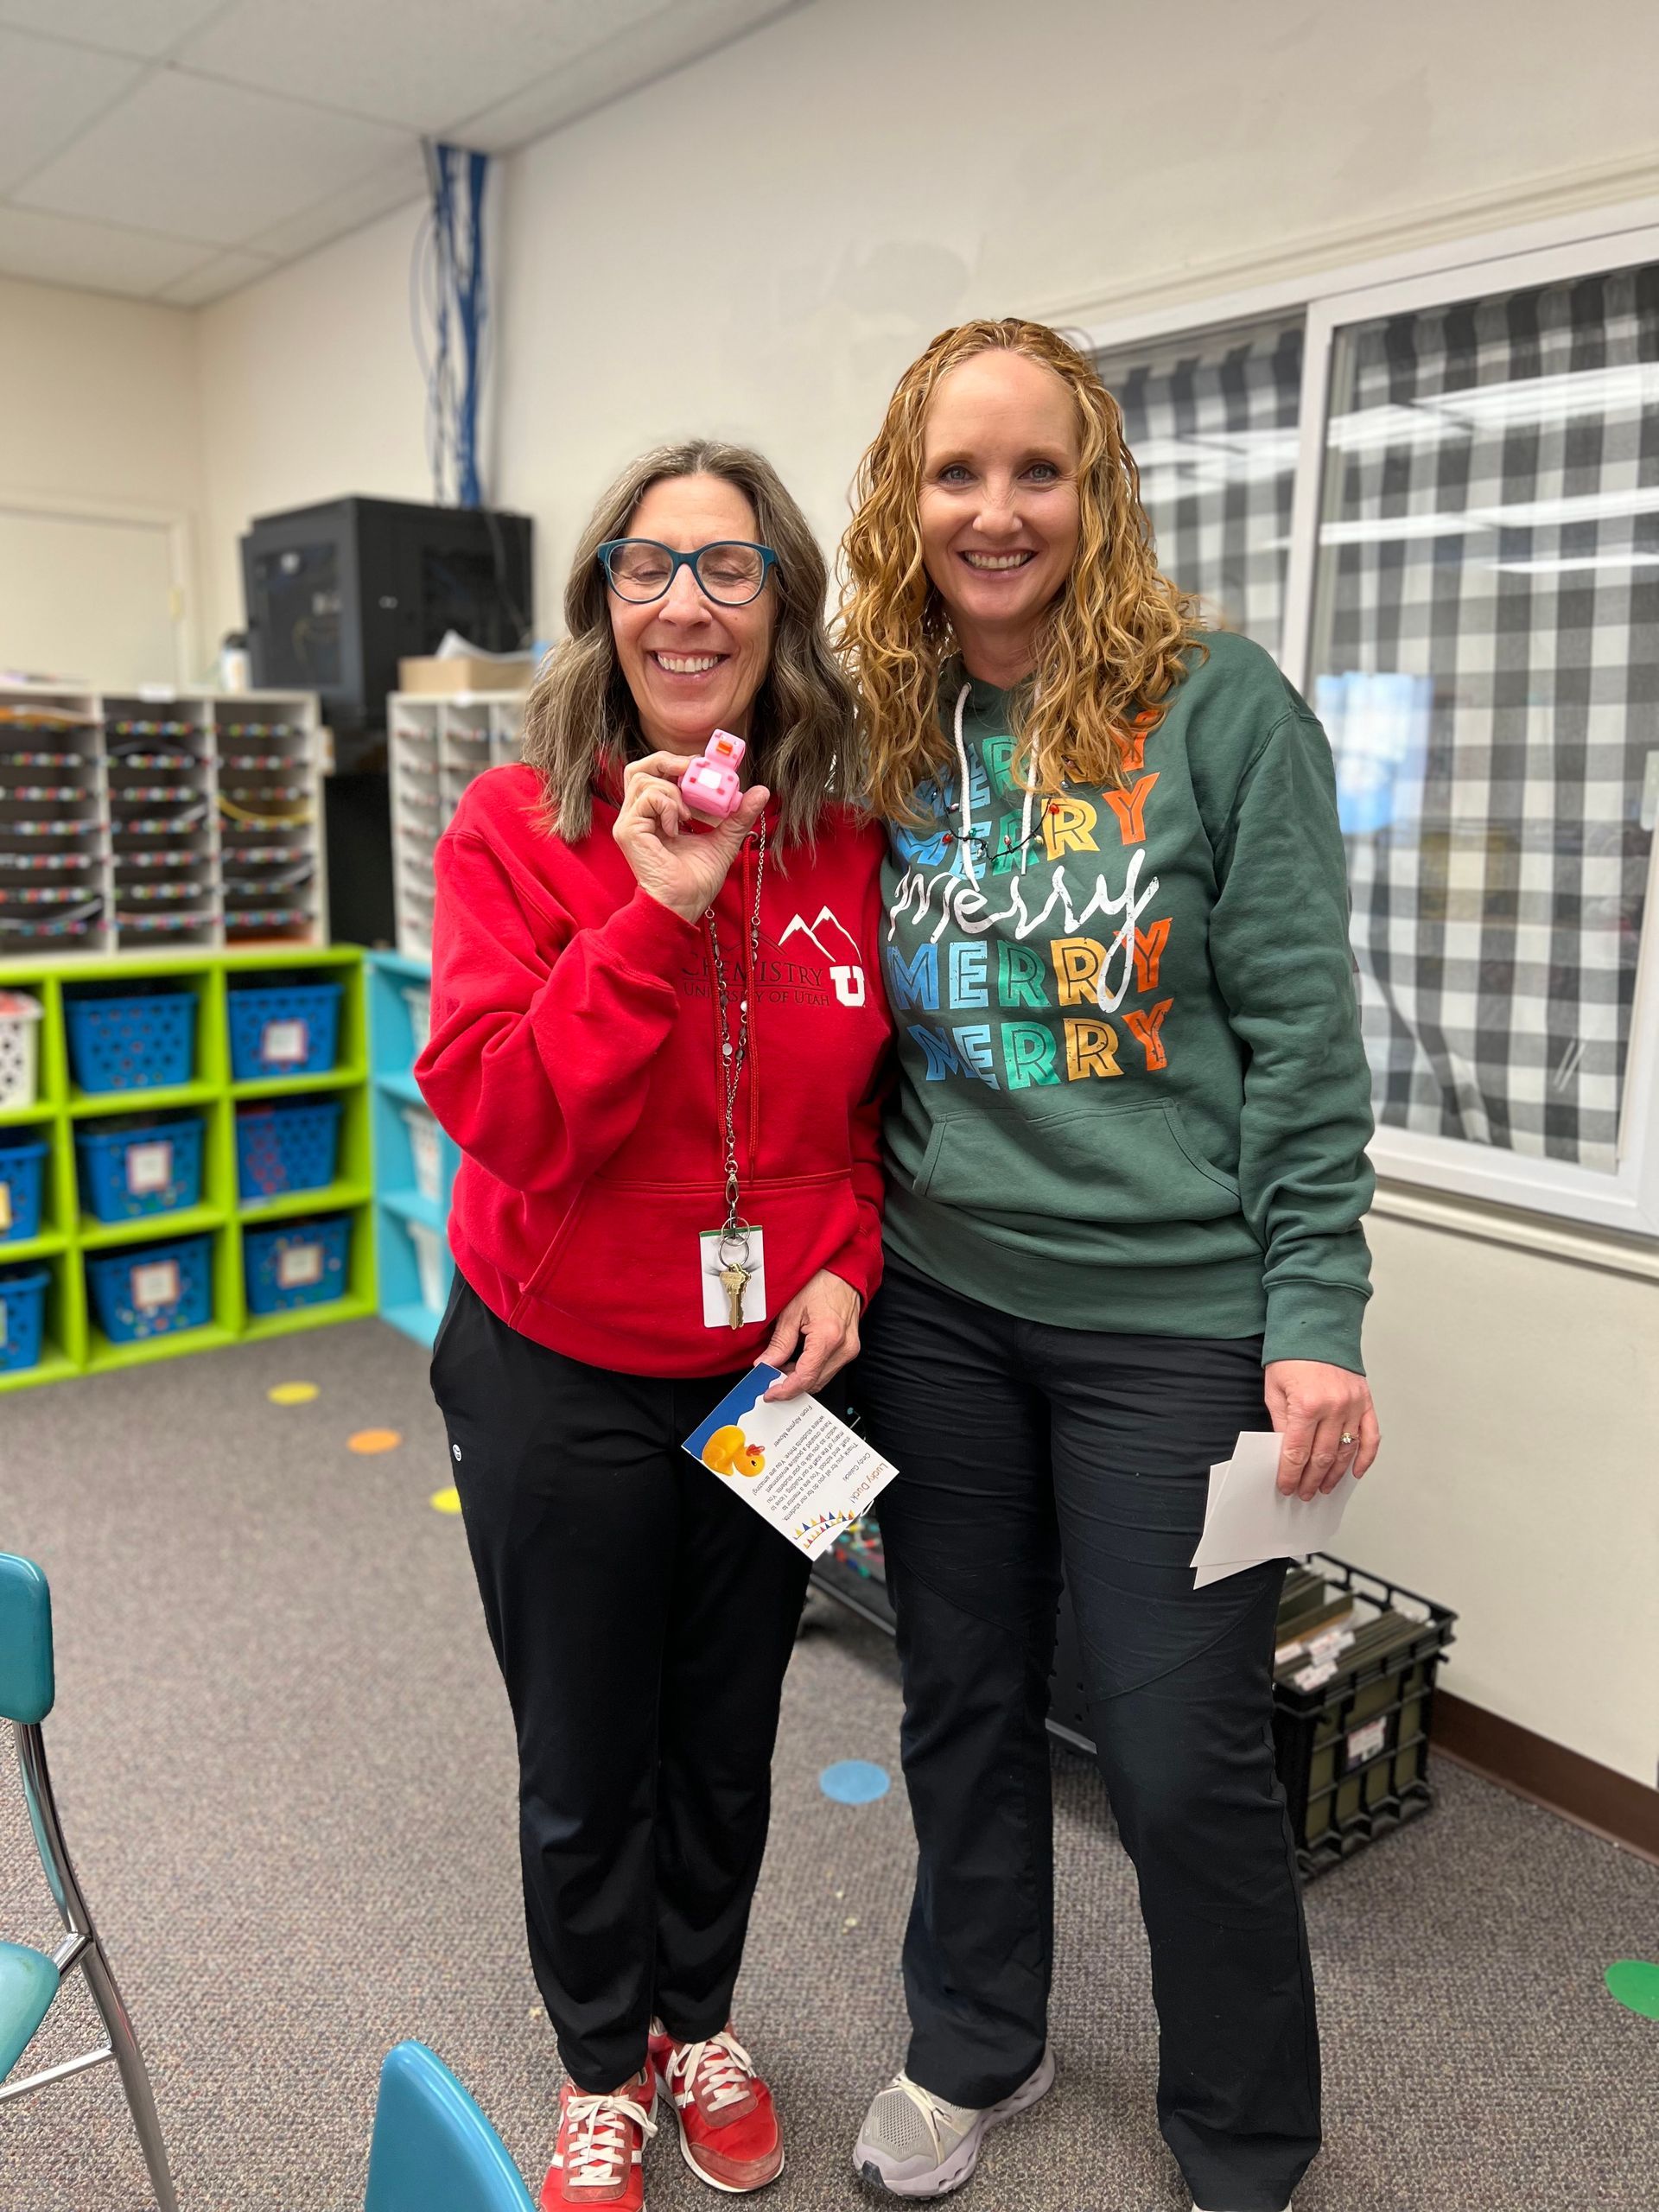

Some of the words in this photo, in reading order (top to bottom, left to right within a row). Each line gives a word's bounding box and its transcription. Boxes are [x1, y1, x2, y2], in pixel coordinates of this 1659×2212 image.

[914, 709, 1160, 815] ERY
[887, 918, 1173, 1010] MERRY
[830, 965, 865, 1007] U
[683, 982, 765, 1003] UNIRSIY
[769, 990, 789, 1003] OF
[794, 991, 830, 1007] UTAH
[906, 997, 1173, 1090] MERRY
[799, 1404, 812, 1417] From
[810, 1414, 824, 1429] where
[819, 1420, 832, 1432] have
[795, 1427, 812, 1446] students
[805, 1431, 821, 1448] created
[831, 1431, 843, 1444] many
[811, 1443, 820, 1453] you
[830, 1446, 841, 1457] and
[842, 1442, 858, 1456] Thank
[787, 1449, 804, 1466] positive
[804, 1452, 814, 1461] talk
[812, 1454, 822, 1466] staff
[836, 1453, 844, 1464] you
[856, 1452, 870, 1465] Cindy
[775, 1459, 785, 1469] You
[791, 1464, 802, 1476] your
[768, 1467, 777, 1476] are
[809, 1471, 820, 1480] You
[866, 1462, 888, 1483] Lucky
[765, 1465, 789, 1492] environment
[802, 1478, 810, 1487] are
[817, 1473, 826, 1484] you
[766, 1494, 777, 1503] You
[786, 1490, 801, 1506] mentor
[849, 1481, 870, 1503] Duck!
[774, 1496, 785, 1506] love
[799, 1495, 808, 1503] our
